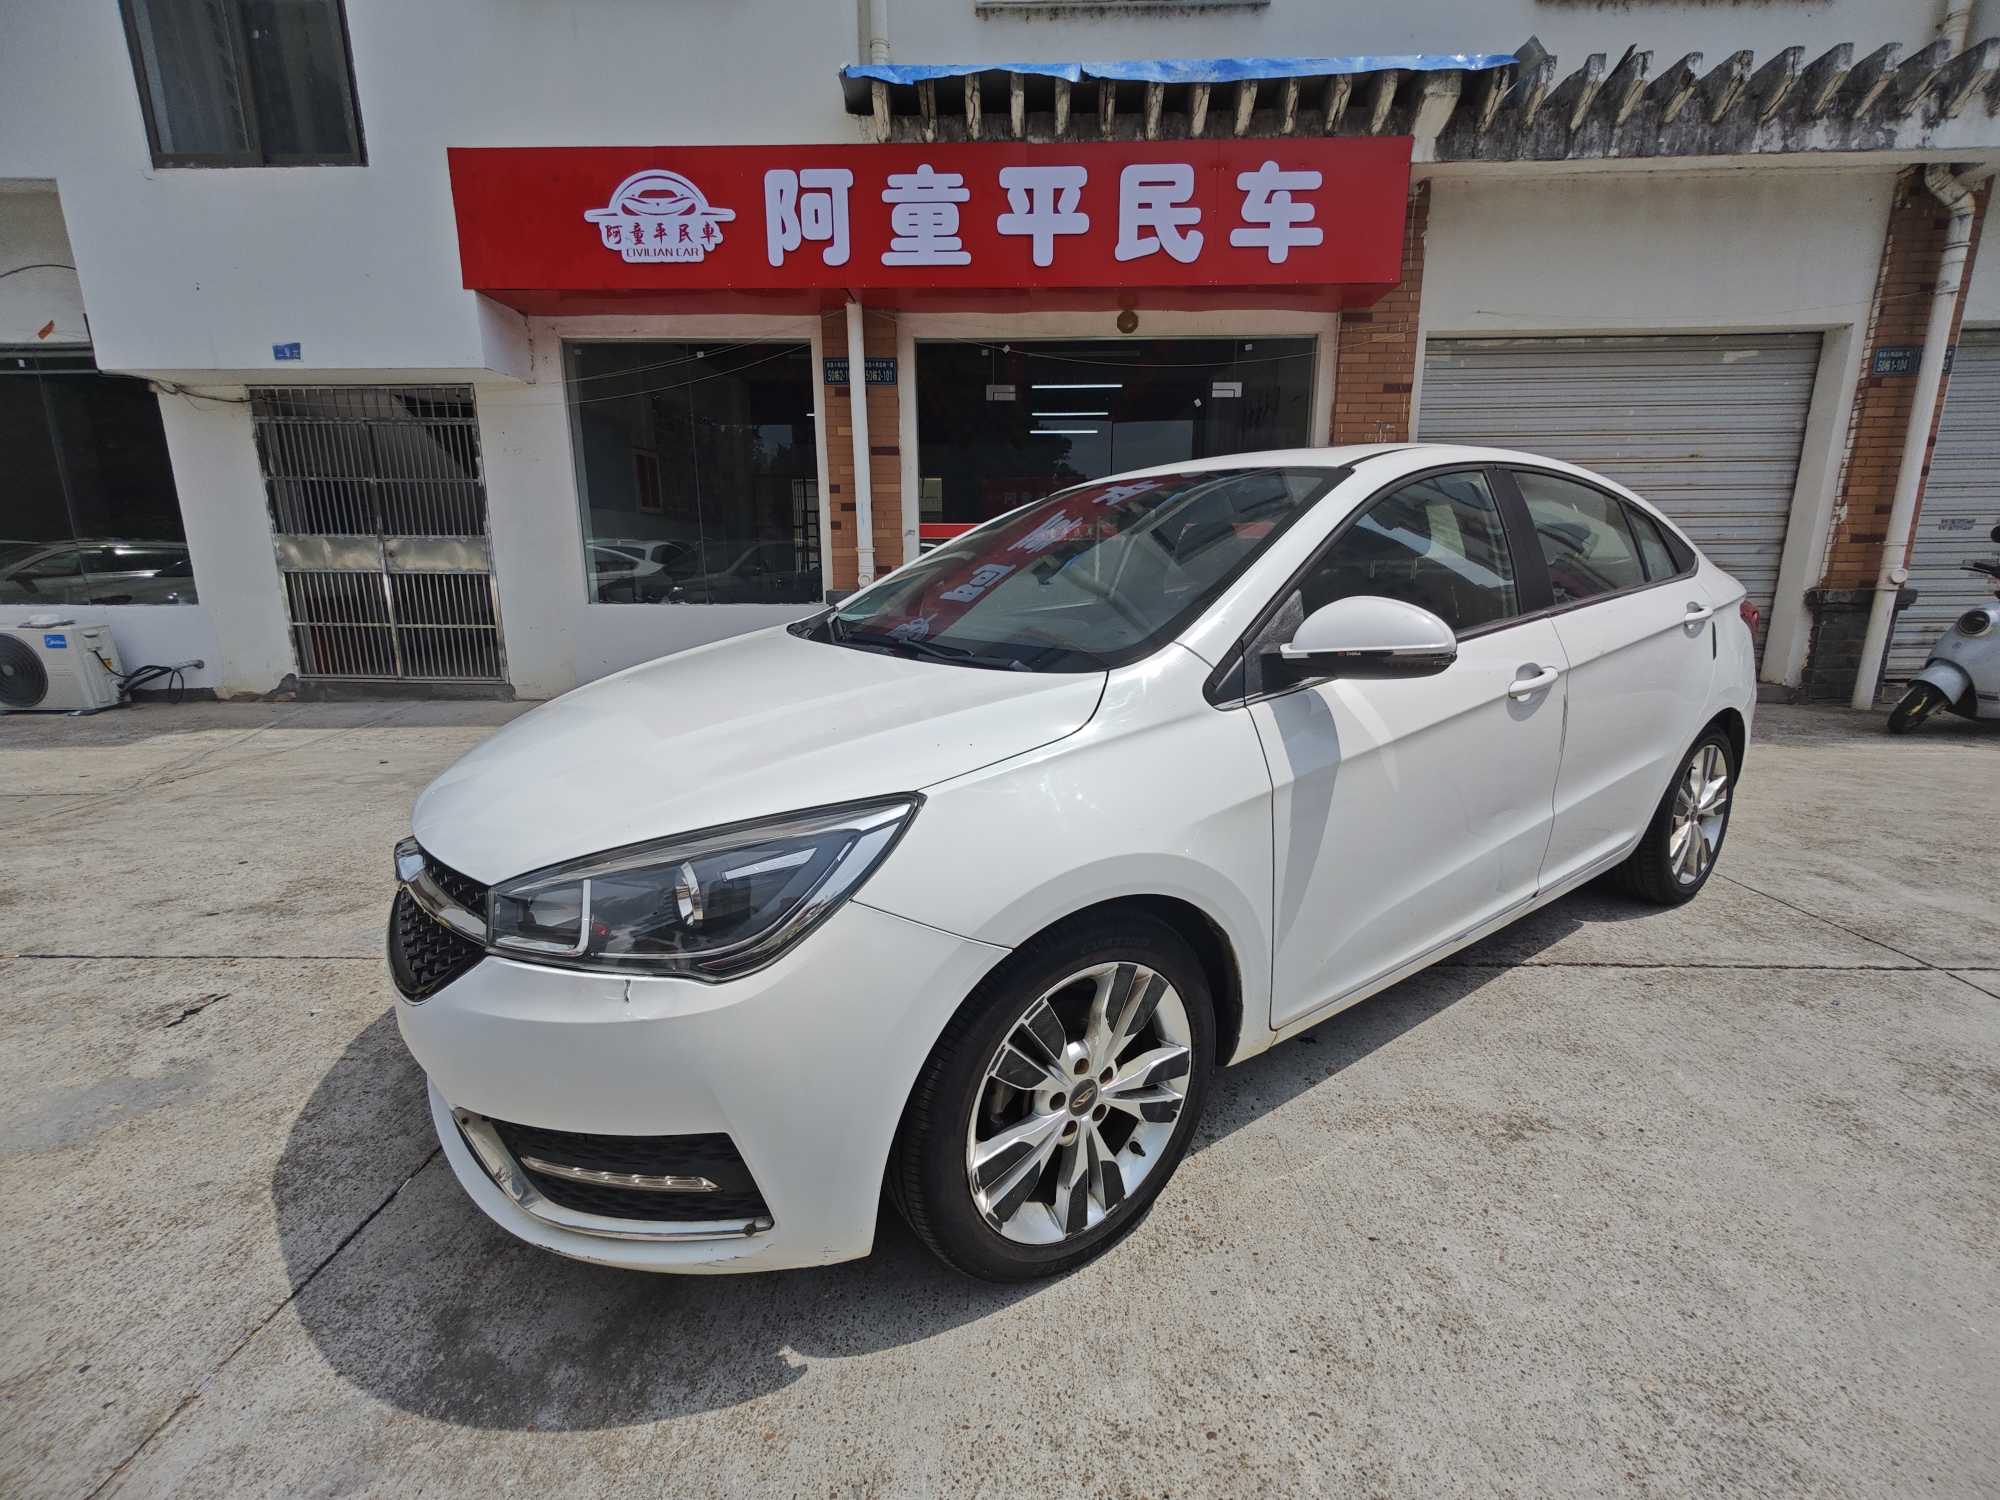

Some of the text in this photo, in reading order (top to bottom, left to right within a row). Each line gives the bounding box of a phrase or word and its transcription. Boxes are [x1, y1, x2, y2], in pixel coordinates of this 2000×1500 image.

[764, 160, 1323, 267] 阿童平民车
[604, 222, 717, 245] 阿童平民車
[626, 247, 699, 257] CIVILIAN CAR
